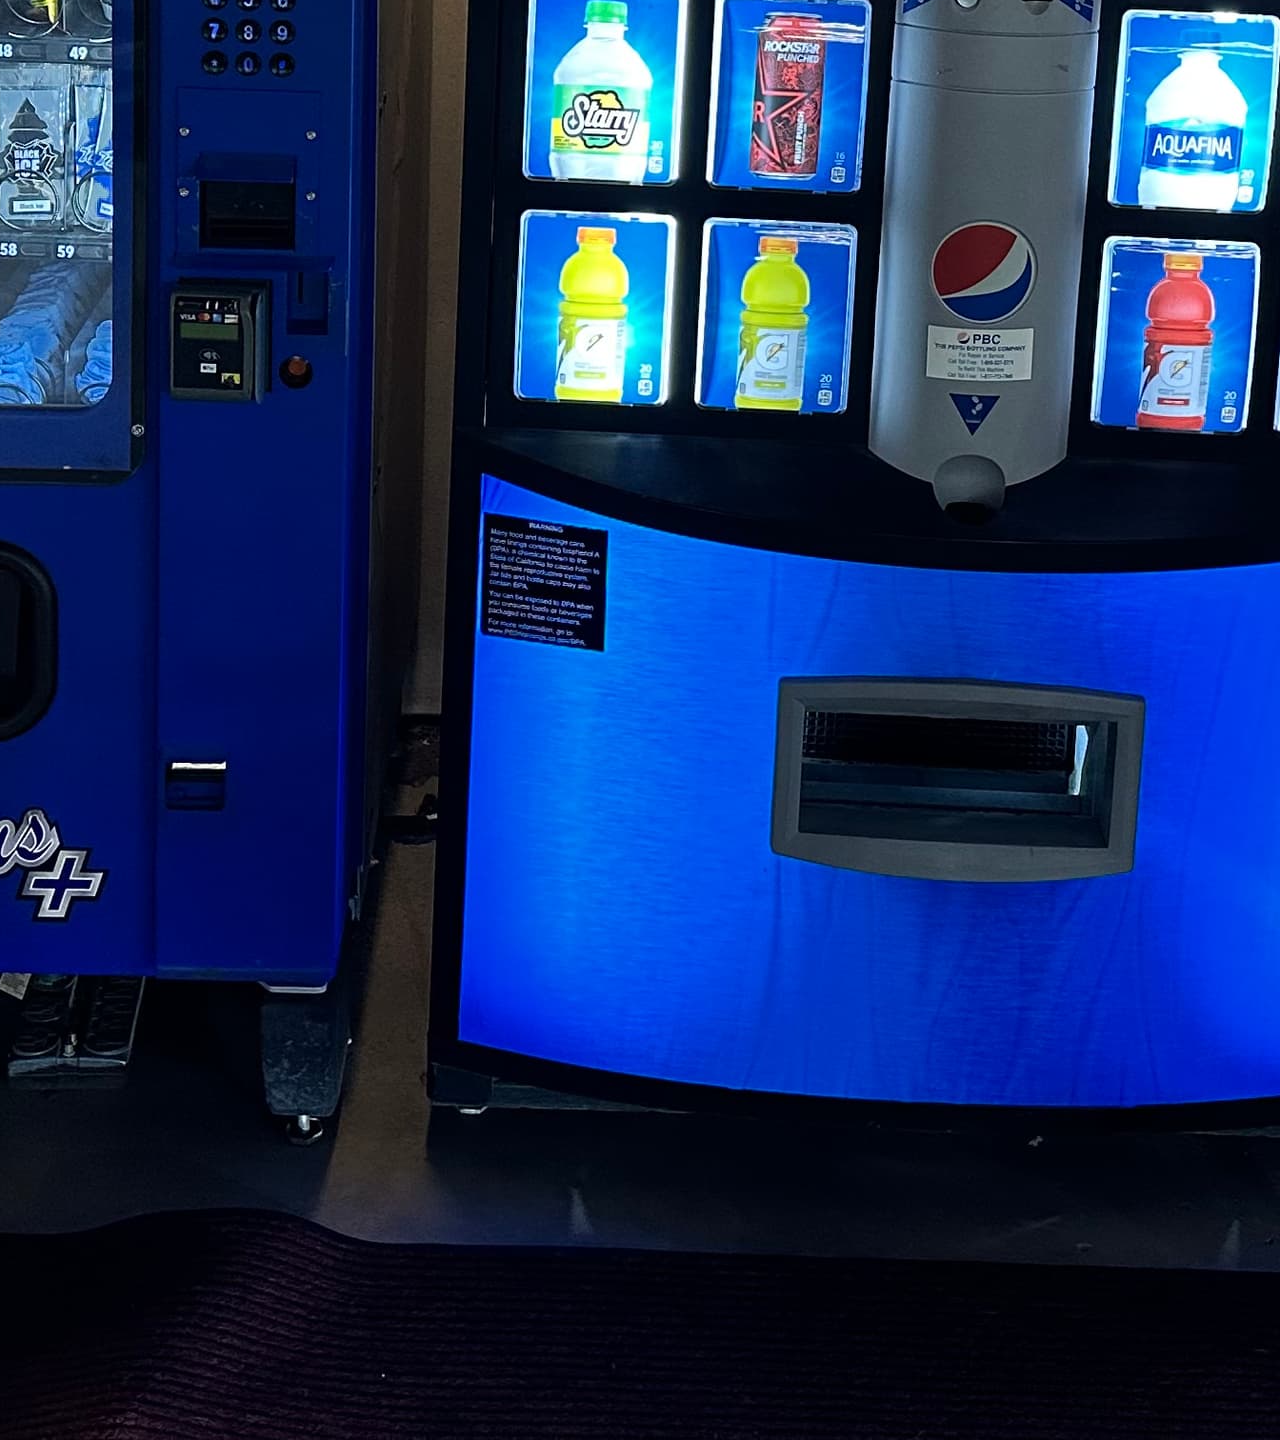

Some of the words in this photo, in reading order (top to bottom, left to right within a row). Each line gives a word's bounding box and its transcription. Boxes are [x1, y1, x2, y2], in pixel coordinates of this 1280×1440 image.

[209, 23, 220, 39] 7
[243, 25, 253, 40] 8
[277, 25, 288, 41] 9
[69, 46, 88, 60] 49
[763, 40, 821, 54] ROCKSTAR
[776, 53, 821, 64] PUNCHED
[754, 101, 766, 123] R
[562, 93, 640, 146] Starry
[1152, 133, 1234, 160] AQUAFINA
[13, 149, 40, 160] BLACK
[834, 151, 846, 161] 16
[0, 242, 18, 257] 58
[56, 244, 75, 259] 59
[972, 334, 1002, 345] PBC
[820, 373, 833, 384] 20
[1223, 390, 1238, 401] 20
